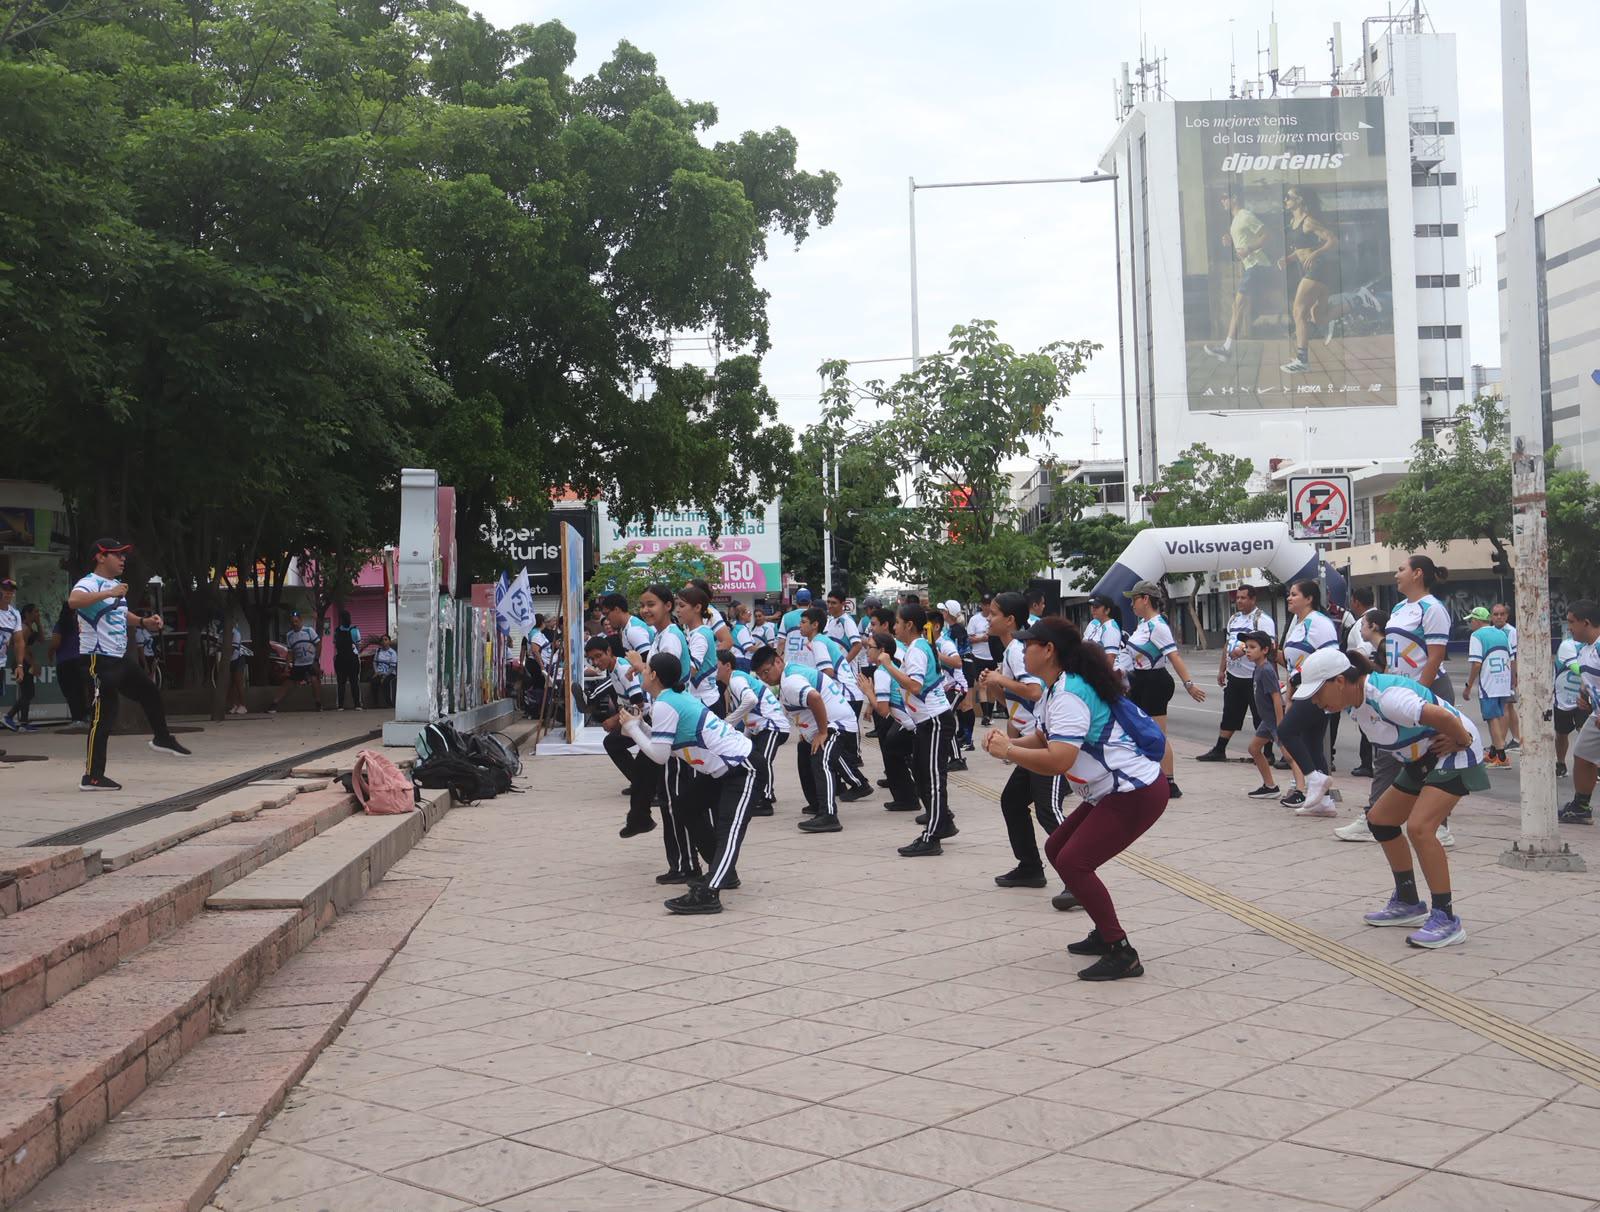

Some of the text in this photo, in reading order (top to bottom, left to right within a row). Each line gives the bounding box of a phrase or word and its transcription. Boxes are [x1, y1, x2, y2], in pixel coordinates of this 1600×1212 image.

[1185, 114, 1298, 129] Los mejores tenis
[1212, 130, 1360, 145] de las mejores marcas
[1221, 152, 1344, 173] dportenis
[1165, 537, 1274, 555] Volkswagen
